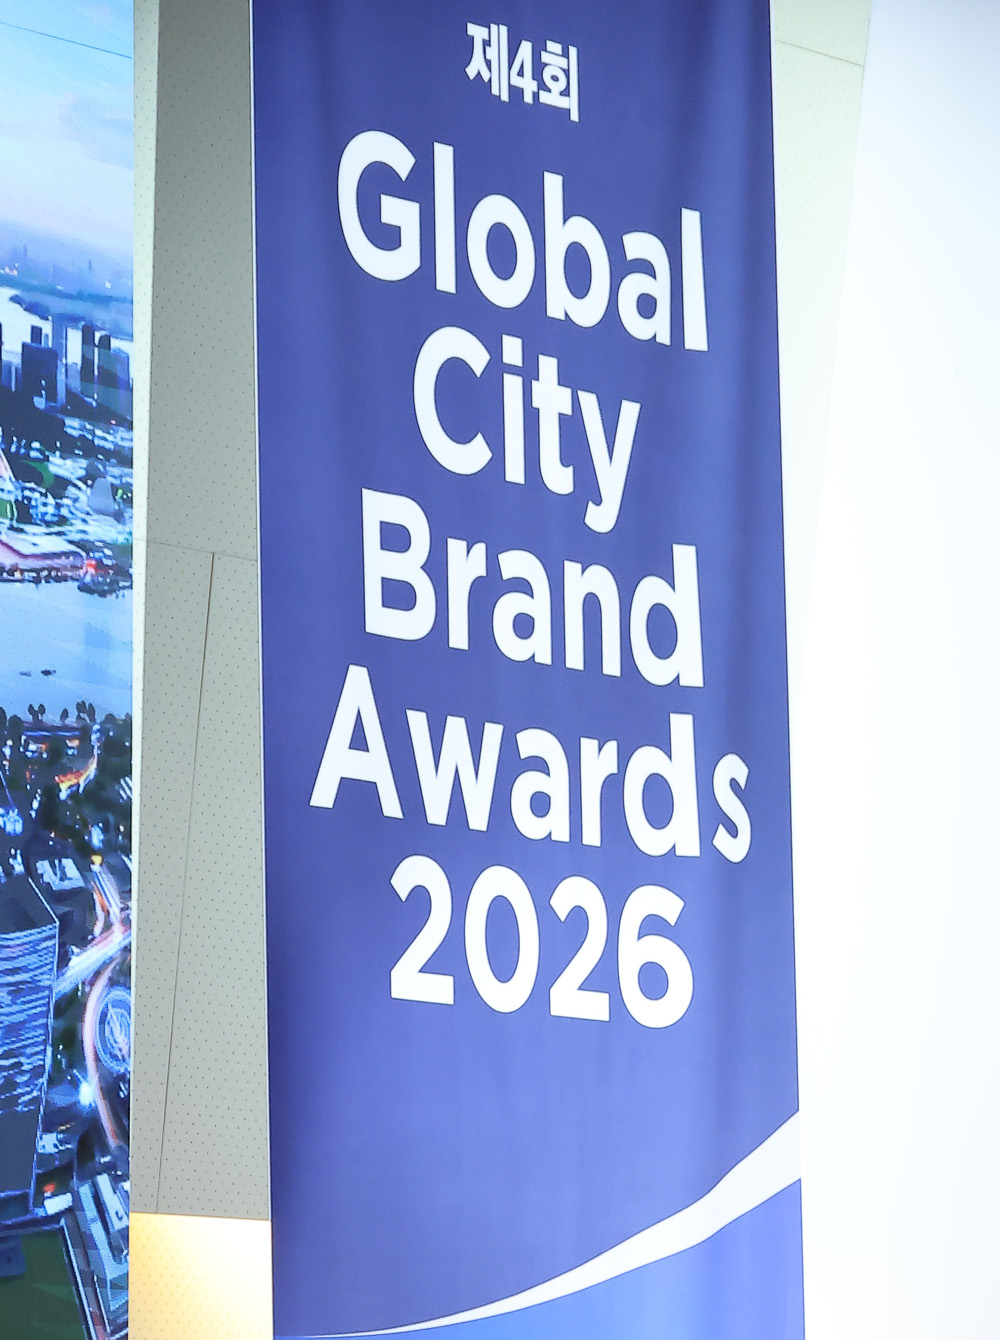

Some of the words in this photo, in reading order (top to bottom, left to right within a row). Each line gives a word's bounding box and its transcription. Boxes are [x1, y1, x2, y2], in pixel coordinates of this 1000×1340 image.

[464, 21, 580, 123] 제4회
[337, 129, 709, 353] Global
[412, 325, 641, 534] City
[360, 486, 705, 689] Brand
[308, 663, 752, 864] Awards
[389, 854, 695, 1030] 2026
